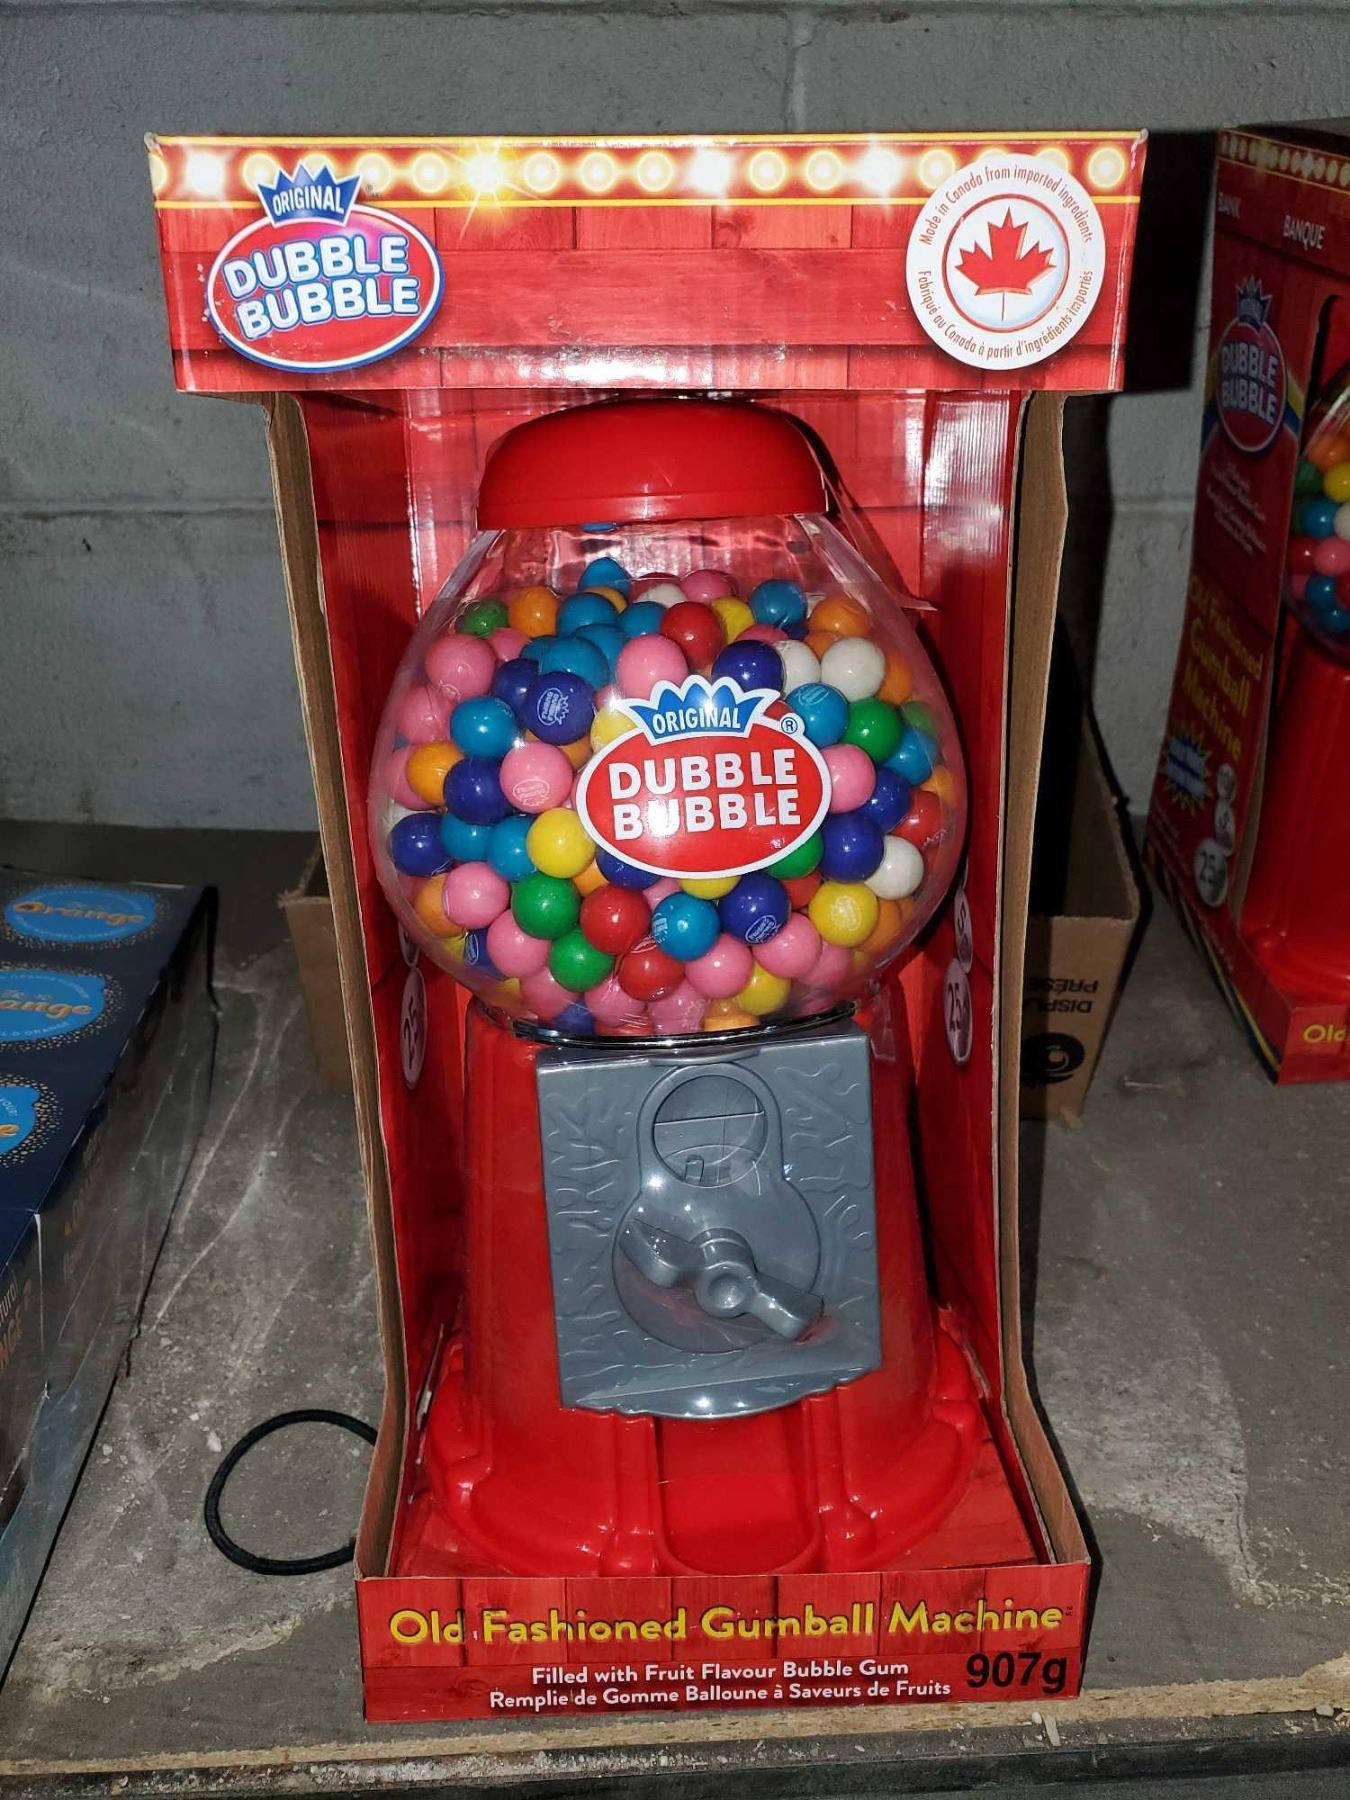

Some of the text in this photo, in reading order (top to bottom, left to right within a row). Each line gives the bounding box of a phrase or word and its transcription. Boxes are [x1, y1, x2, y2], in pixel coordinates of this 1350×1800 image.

[272, 186, 345, 216] ORIGINAL
[918, 164, 1094, 246] Made in Canada from imported ingredients
[1283, 214, 1326, 251] BANQUE
[223, 235, 409, 299] DUBBLE
[236, 278, 420, 339] BUBBLE
[932, 315, 946, 329] au
[944, 323, 977, 354] Canada
[986, 345, 1013, 361] partir
[1221, 342, 1279, 390] DUBBLE
[1221, 378, 1277, 427] BUBBLE
[652, 706, 742, 736] ORIGINAL
[608, 748, 798, 800] DUBBLE
[612, 788, 802, 841] BUBBLE
[0, 1000, 92, 1020] ange
[388, 1598, 1063, 1645] Old Fashioned Gumball Machine
[532, 1658, 909, 1686] Filled with Fruit Flavour Bubble Gum
[965, 1651, 1068, 1695] 907g
[489, 1679, 951, 1713] Remplie de Gomme Balloune à Saveurs de Fruits
